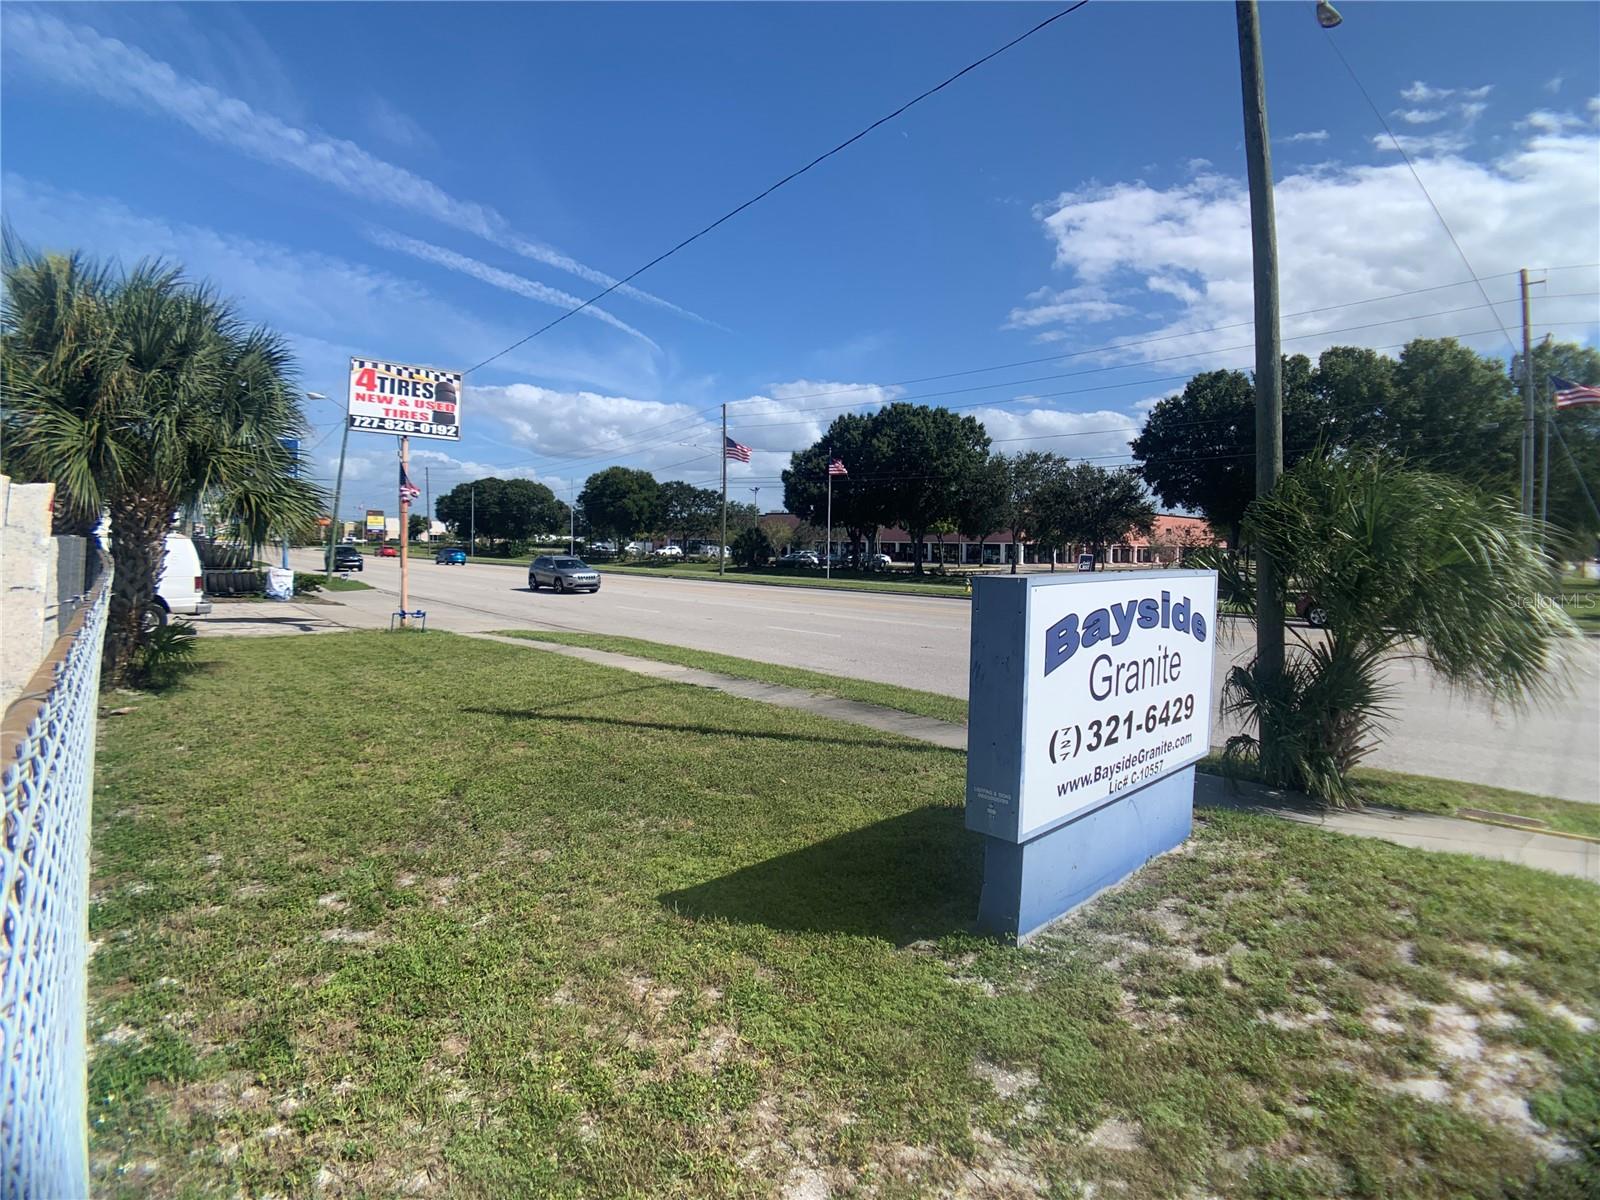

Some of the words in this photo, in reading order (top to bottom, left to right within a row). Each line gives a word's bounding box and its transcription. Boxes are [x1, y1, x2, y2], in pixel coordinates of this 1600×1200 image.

[355, 392, 394, 405] NEW
[397, 399, 410, 407] &
[414, 400, 456, 413] USED
[383, 408, 430, 422] TIRES
[353, 416, 457, 436] 727-826-0192
[1043, 590, 1208, 678] Bayside
[1089, 644, 1182, 701] Granite
[1086, 693, 1195, 752] 321-6429
[1056, 732, 1193, 797] www.BaysideGranite.com
[1108, 777, 1129, 795] Lic#
[1130, 759, 1165, 785] C-10557
